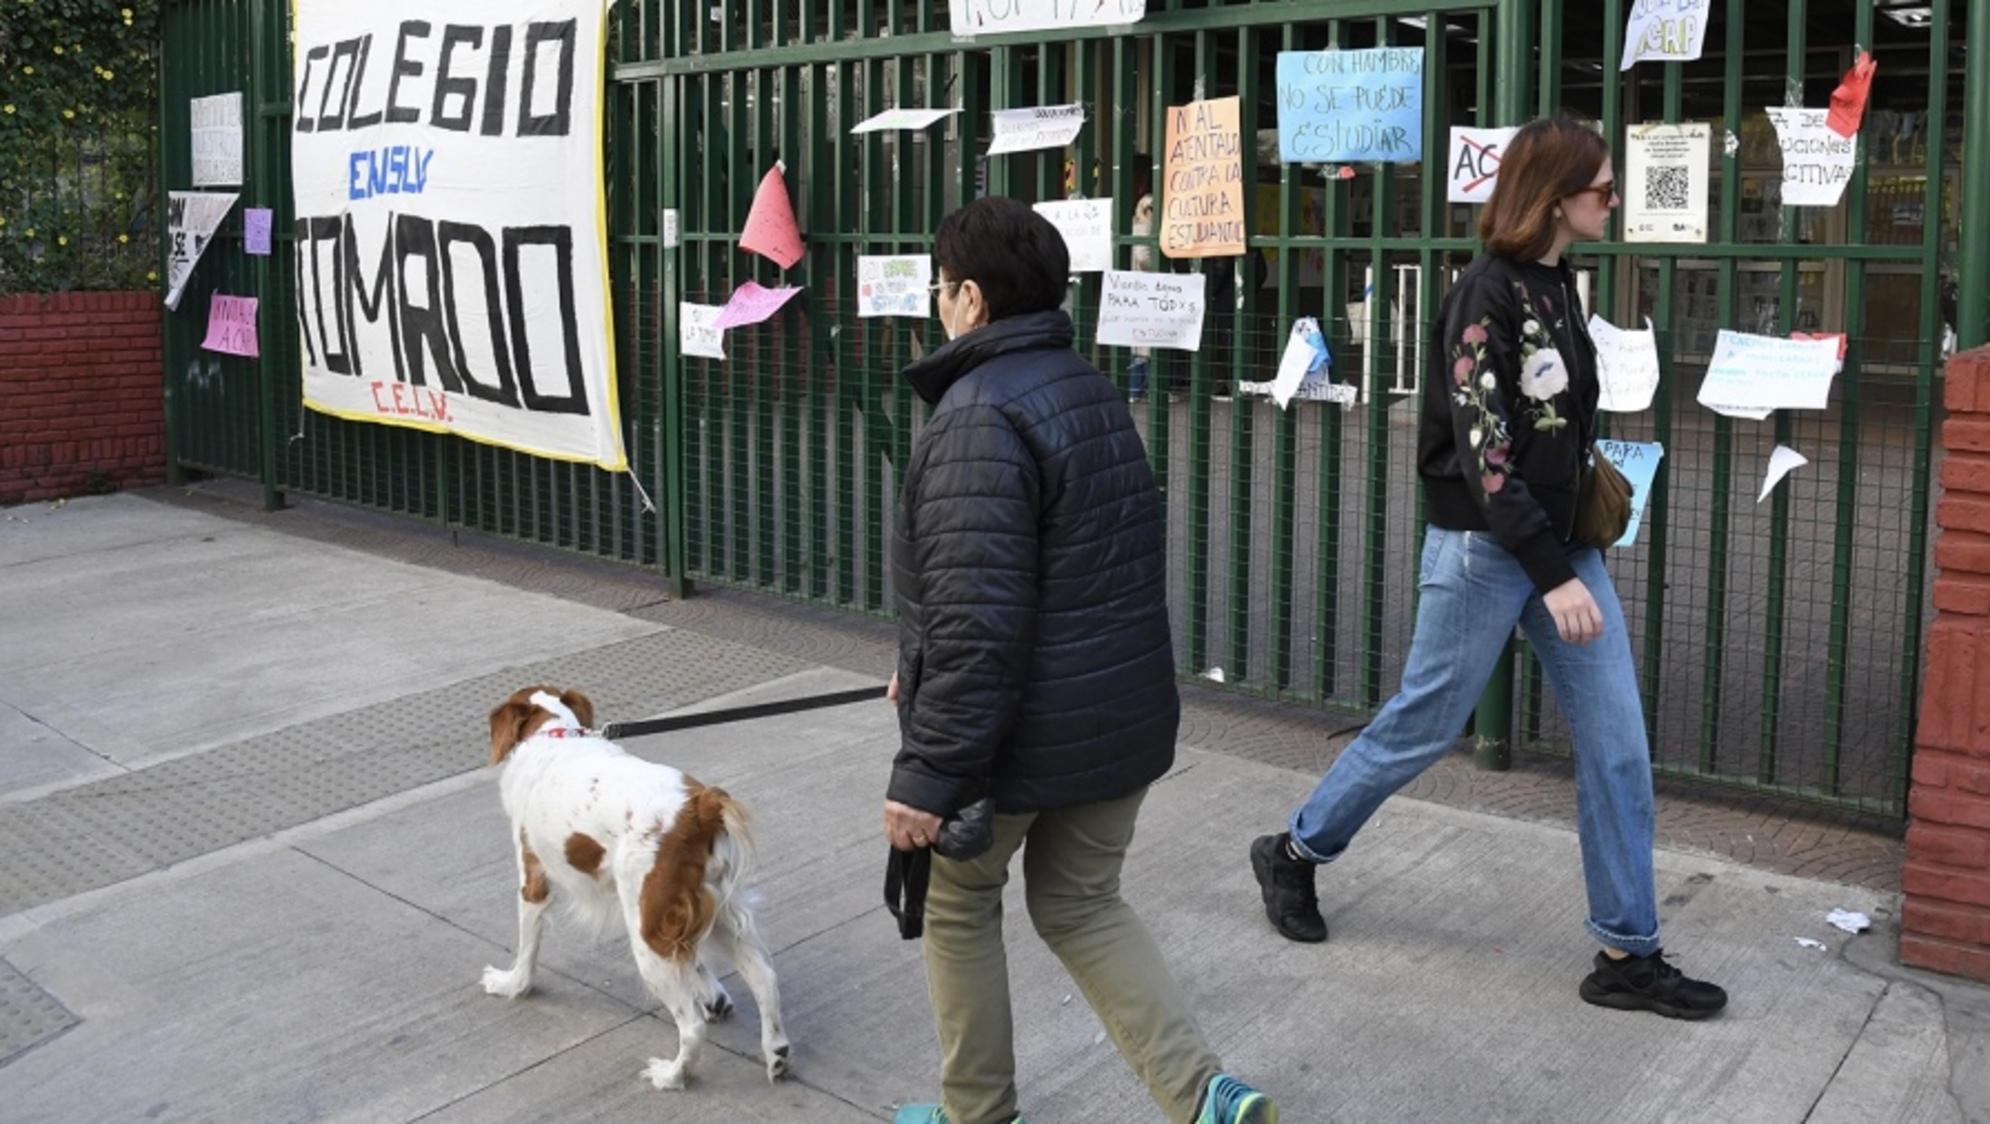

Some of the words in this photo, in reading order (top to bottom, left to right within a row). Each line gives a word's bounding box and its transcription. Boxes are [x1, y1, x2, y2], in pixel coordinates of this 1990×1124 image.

[295, 17, 577, 137] COLEGIO
[1303, 53, 1345, 74] CON
[1280, 83, 1305, 111] NO
[1315, 84, 1345, 114] SE
[349, 146, 434, 200] ENSLV
[294, 211, 591, 416] TOMADO
[1107, 292, 1141, 309] PARA
[1604, 441, 1644, 460] PARA
